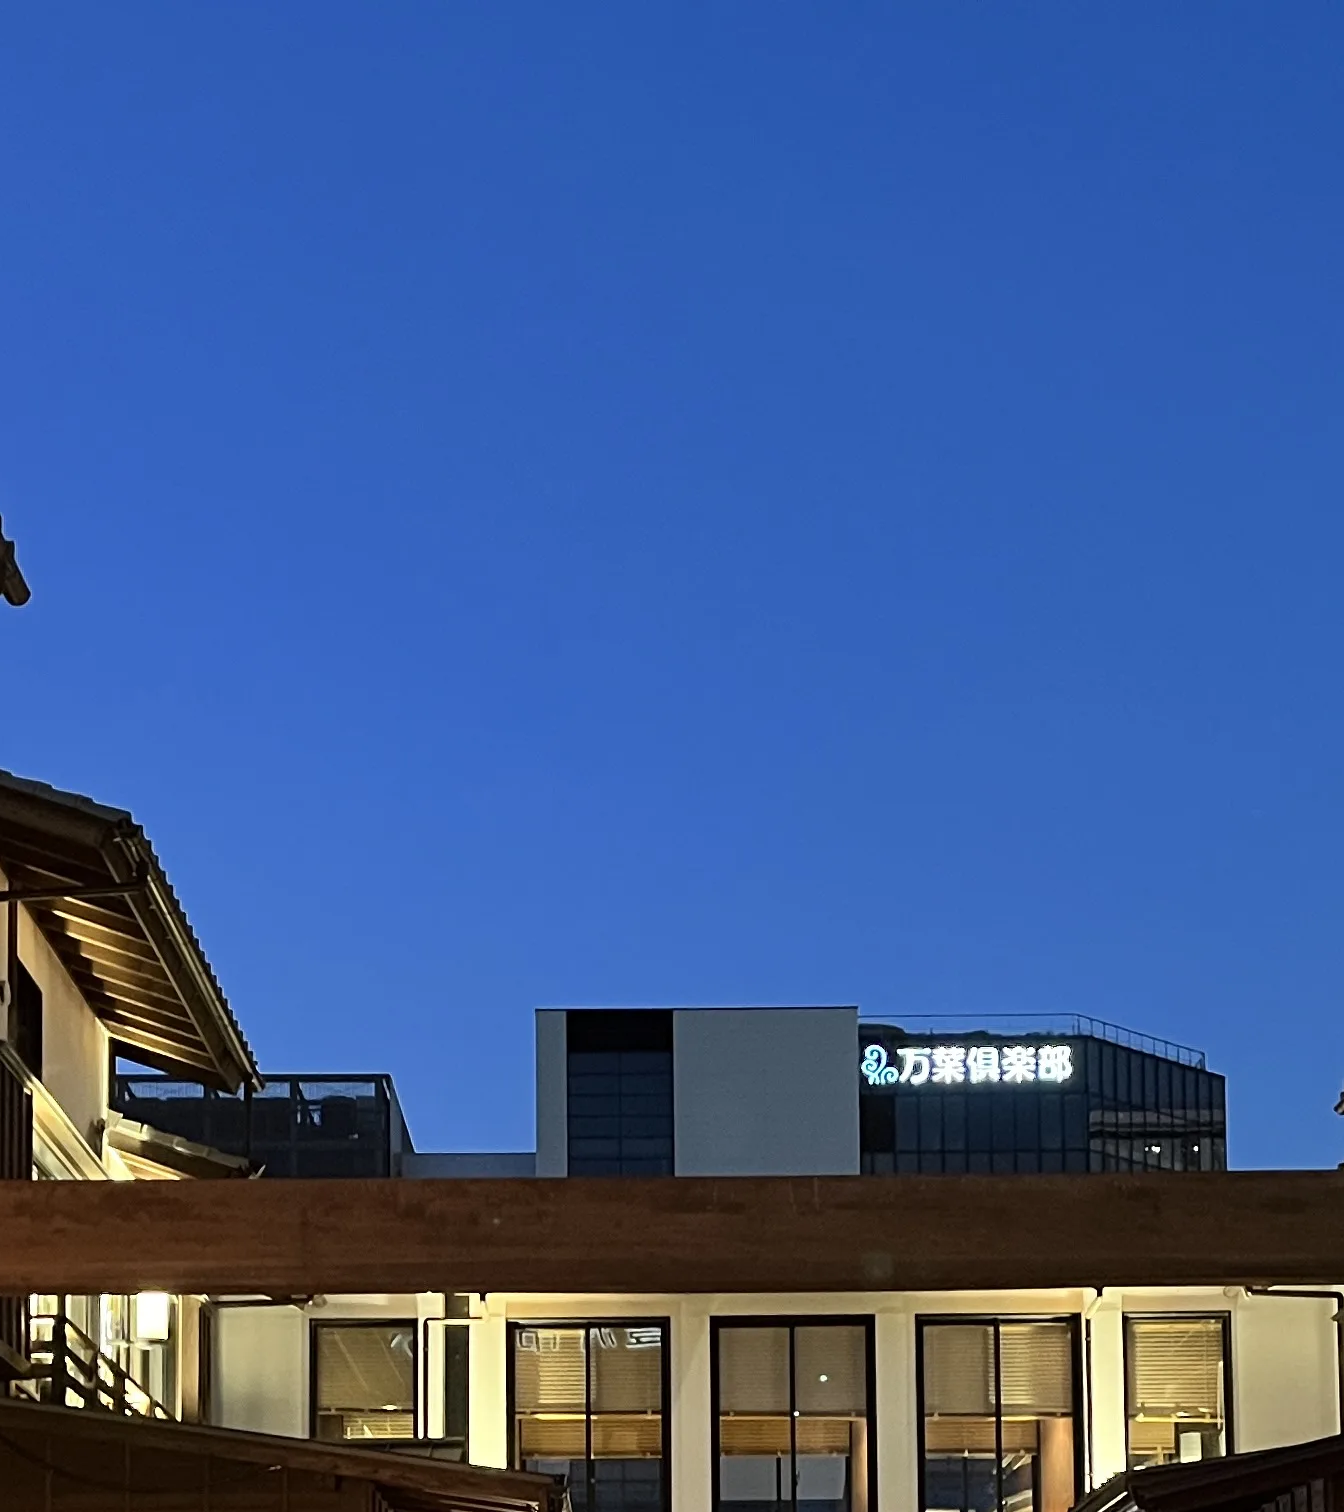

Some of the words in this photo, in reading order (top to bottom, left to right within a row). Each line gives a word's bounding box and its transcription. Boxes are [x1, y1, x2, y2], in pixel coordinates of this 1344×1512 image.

[896, 1043, 1074, 1084] 万葉倶楽部
